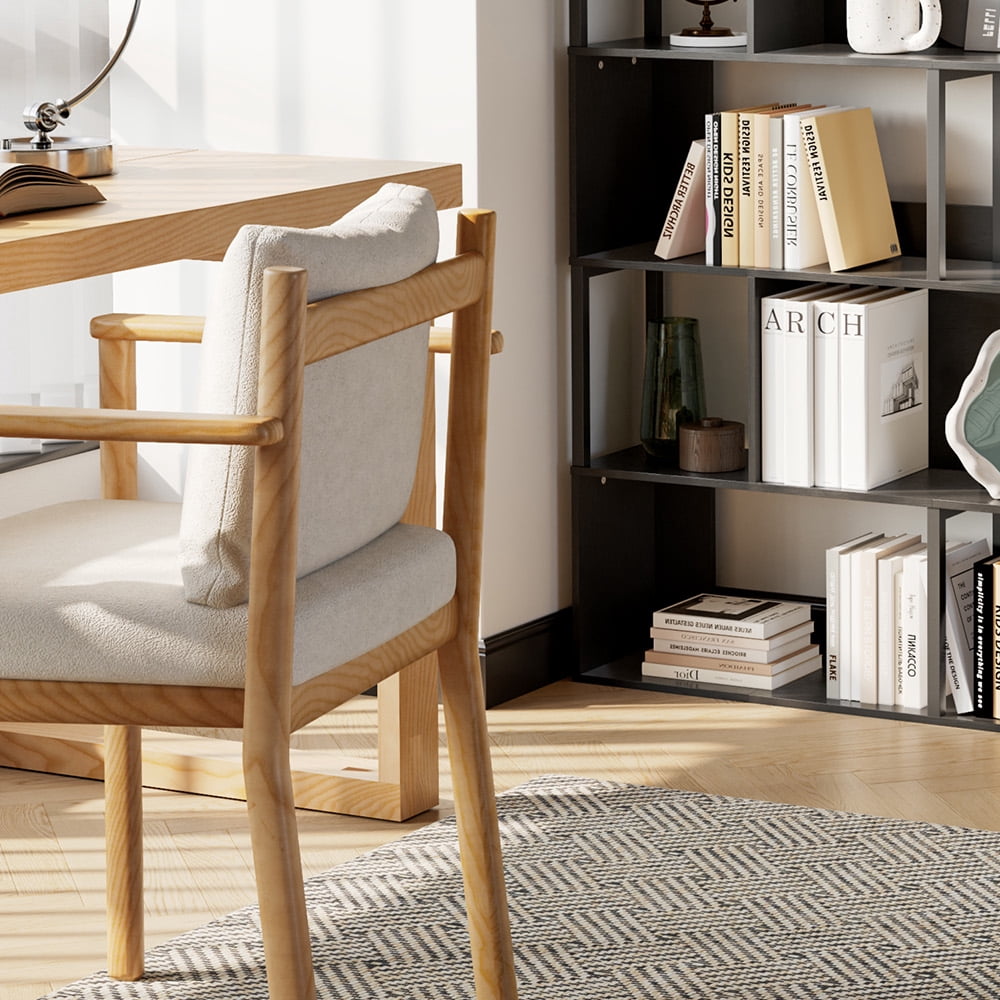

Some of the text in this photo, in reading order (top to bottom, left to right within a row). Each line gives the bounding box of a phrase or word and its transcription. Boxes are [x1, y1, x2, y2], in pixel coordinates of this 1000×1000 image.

[976, 572, 985, 614] simplicity
[977, 615, 985, 624] is
[977, 625, 985, 634] in
[829, 654, 838, 681] FLAKE
[907, 633, 917, 678] ПИКАССО
[946, 652, 955, 665] THE
[976, 635, 985, 680] everything
[948, 665, 961, 691] DESIGN
[977, 681, 984, 693] we
